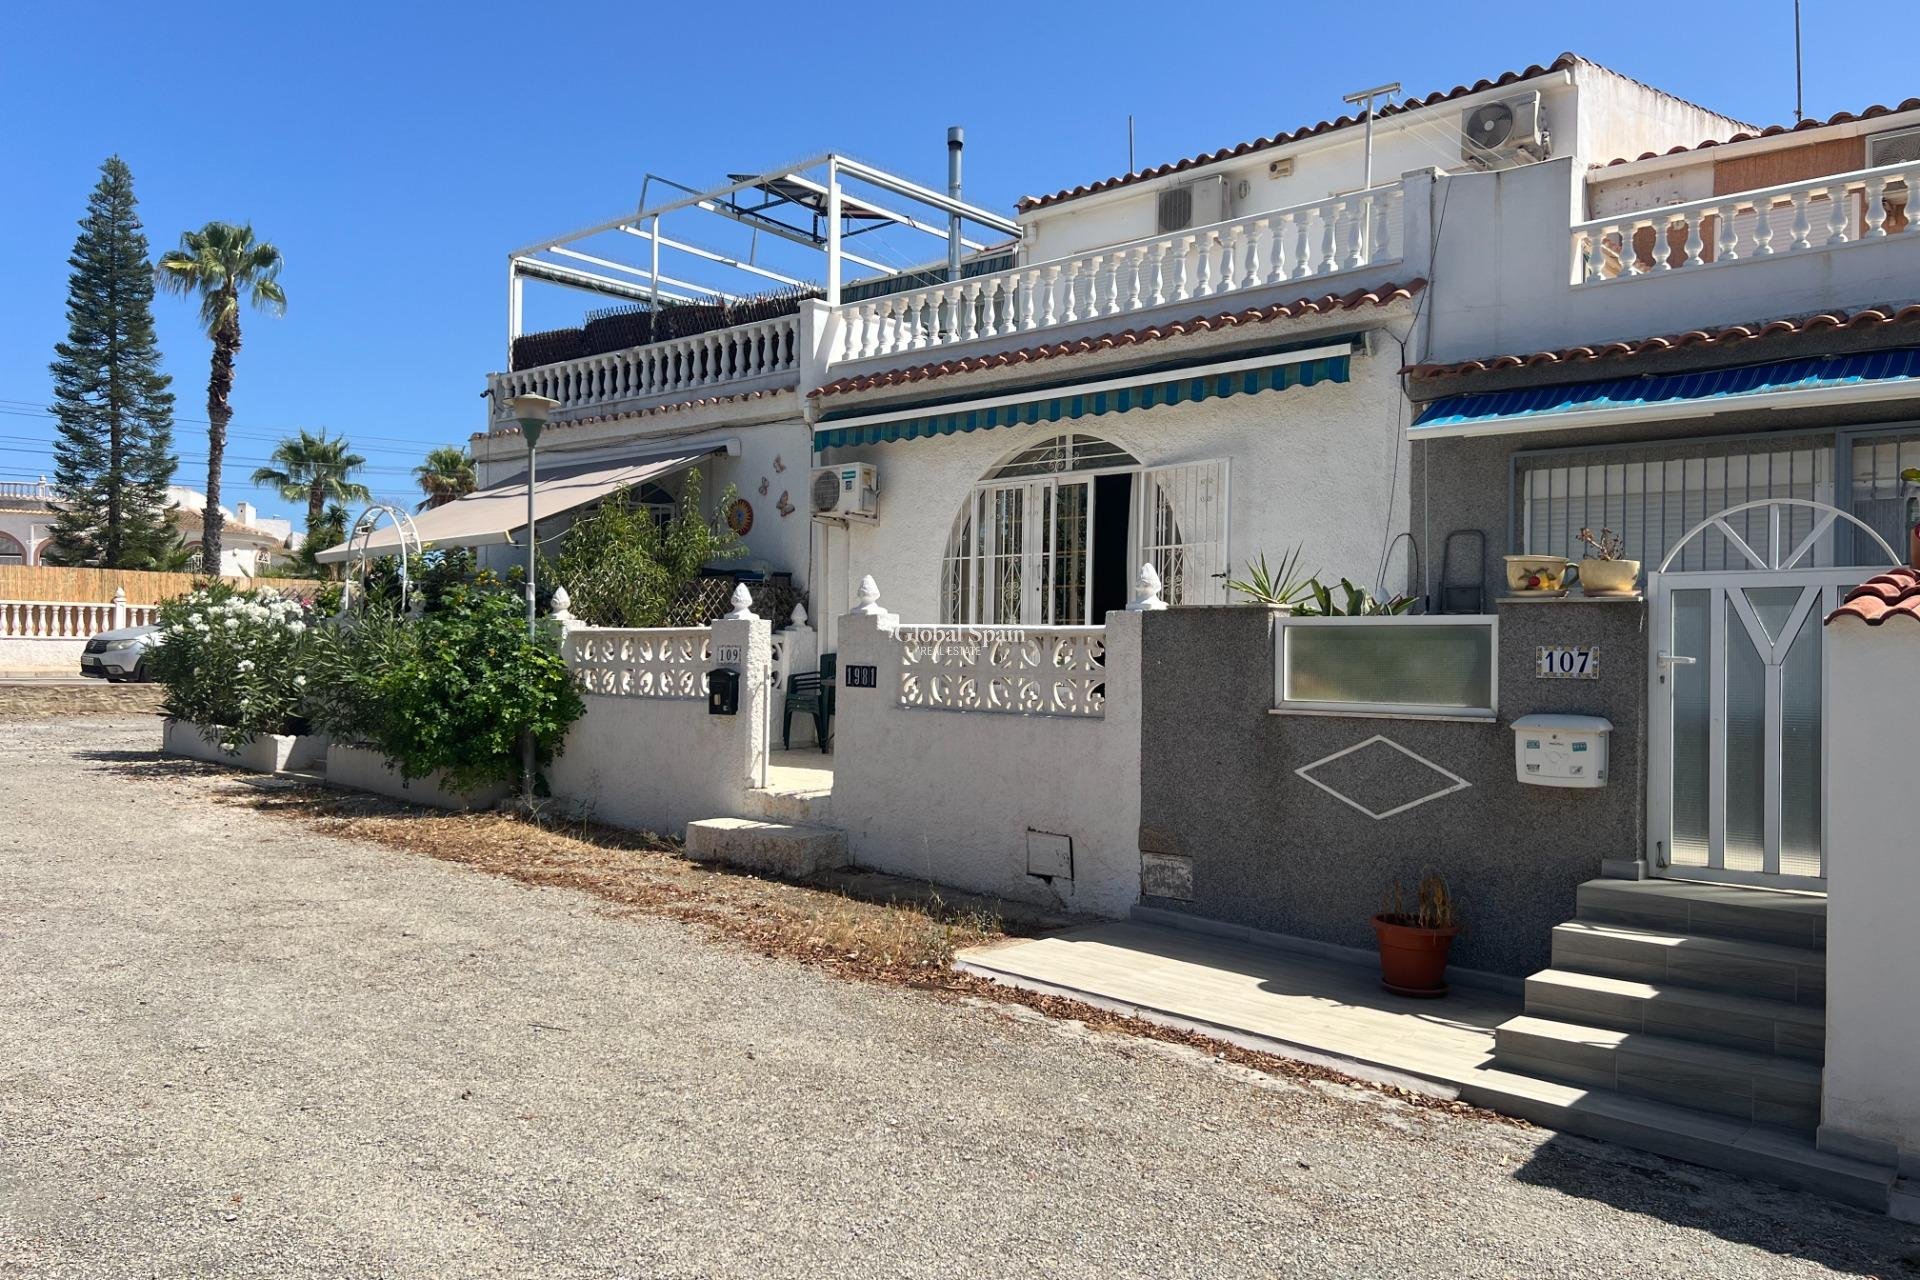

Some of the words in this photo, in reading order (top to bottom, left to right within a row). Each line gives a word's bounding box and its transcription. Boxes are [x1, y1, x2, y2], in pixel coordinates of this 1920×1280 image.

[720, 649, 738, 662] 109
[1545, 651, 1590, 673] 107
[847, 666, 876, 686] 1981
